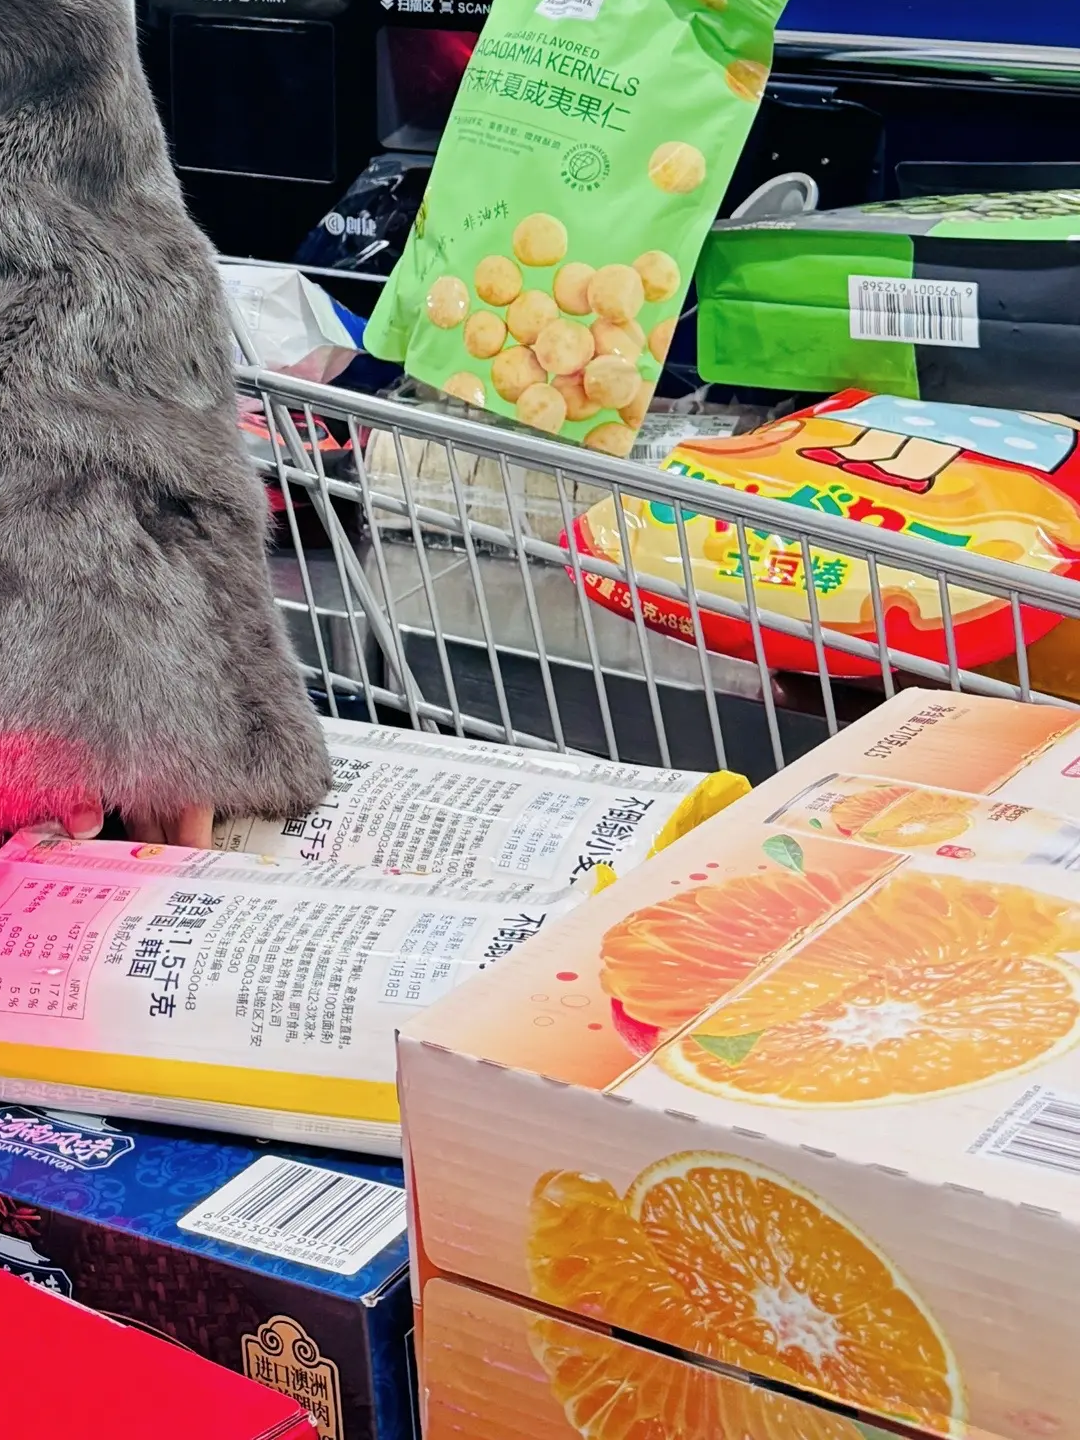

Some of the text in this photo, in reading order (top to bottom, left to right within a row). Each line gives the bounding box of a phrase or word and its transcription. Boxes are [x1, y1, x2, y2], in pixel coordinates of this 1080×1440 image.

[457, 1, 492, 15] SCAN
[536, 32, 600, 60] FLAVORED
[545, 51, 640, 97] KERNELS
[462, 65, 631, 133] 芥末味夏威夷果仁
[463, 200, 509, 231] 非油炸
[862, 280, 973, 298] 6 975001 612368
[720, 548, 849, 594] 土豆棒
[367, 812, 384, 838] 9930
[0, 926, 23, 957] 69.0克
[68, 921, 85, 940] 1437
[105, 915, 143, 964] 营养成分表
[126, 891, 198, 979] 原产国:韩国
[19, 933, 39, 958] 3.0克
[38, 934, 58, 960] 9.0克
[77, 931, 99, 963] 每100克
[227, 946, 244, 974] 9930
[10, 986, 21, 994] 5
[29, 981, 41, 995] 15
[49, 983, 61, 997] 17
[23, 1150, 75, 1172] FLAVOR
[203, 1211, 349, 1256] 6 925303 799717
[255, 1354, 329, 1401] 进口澳洲
